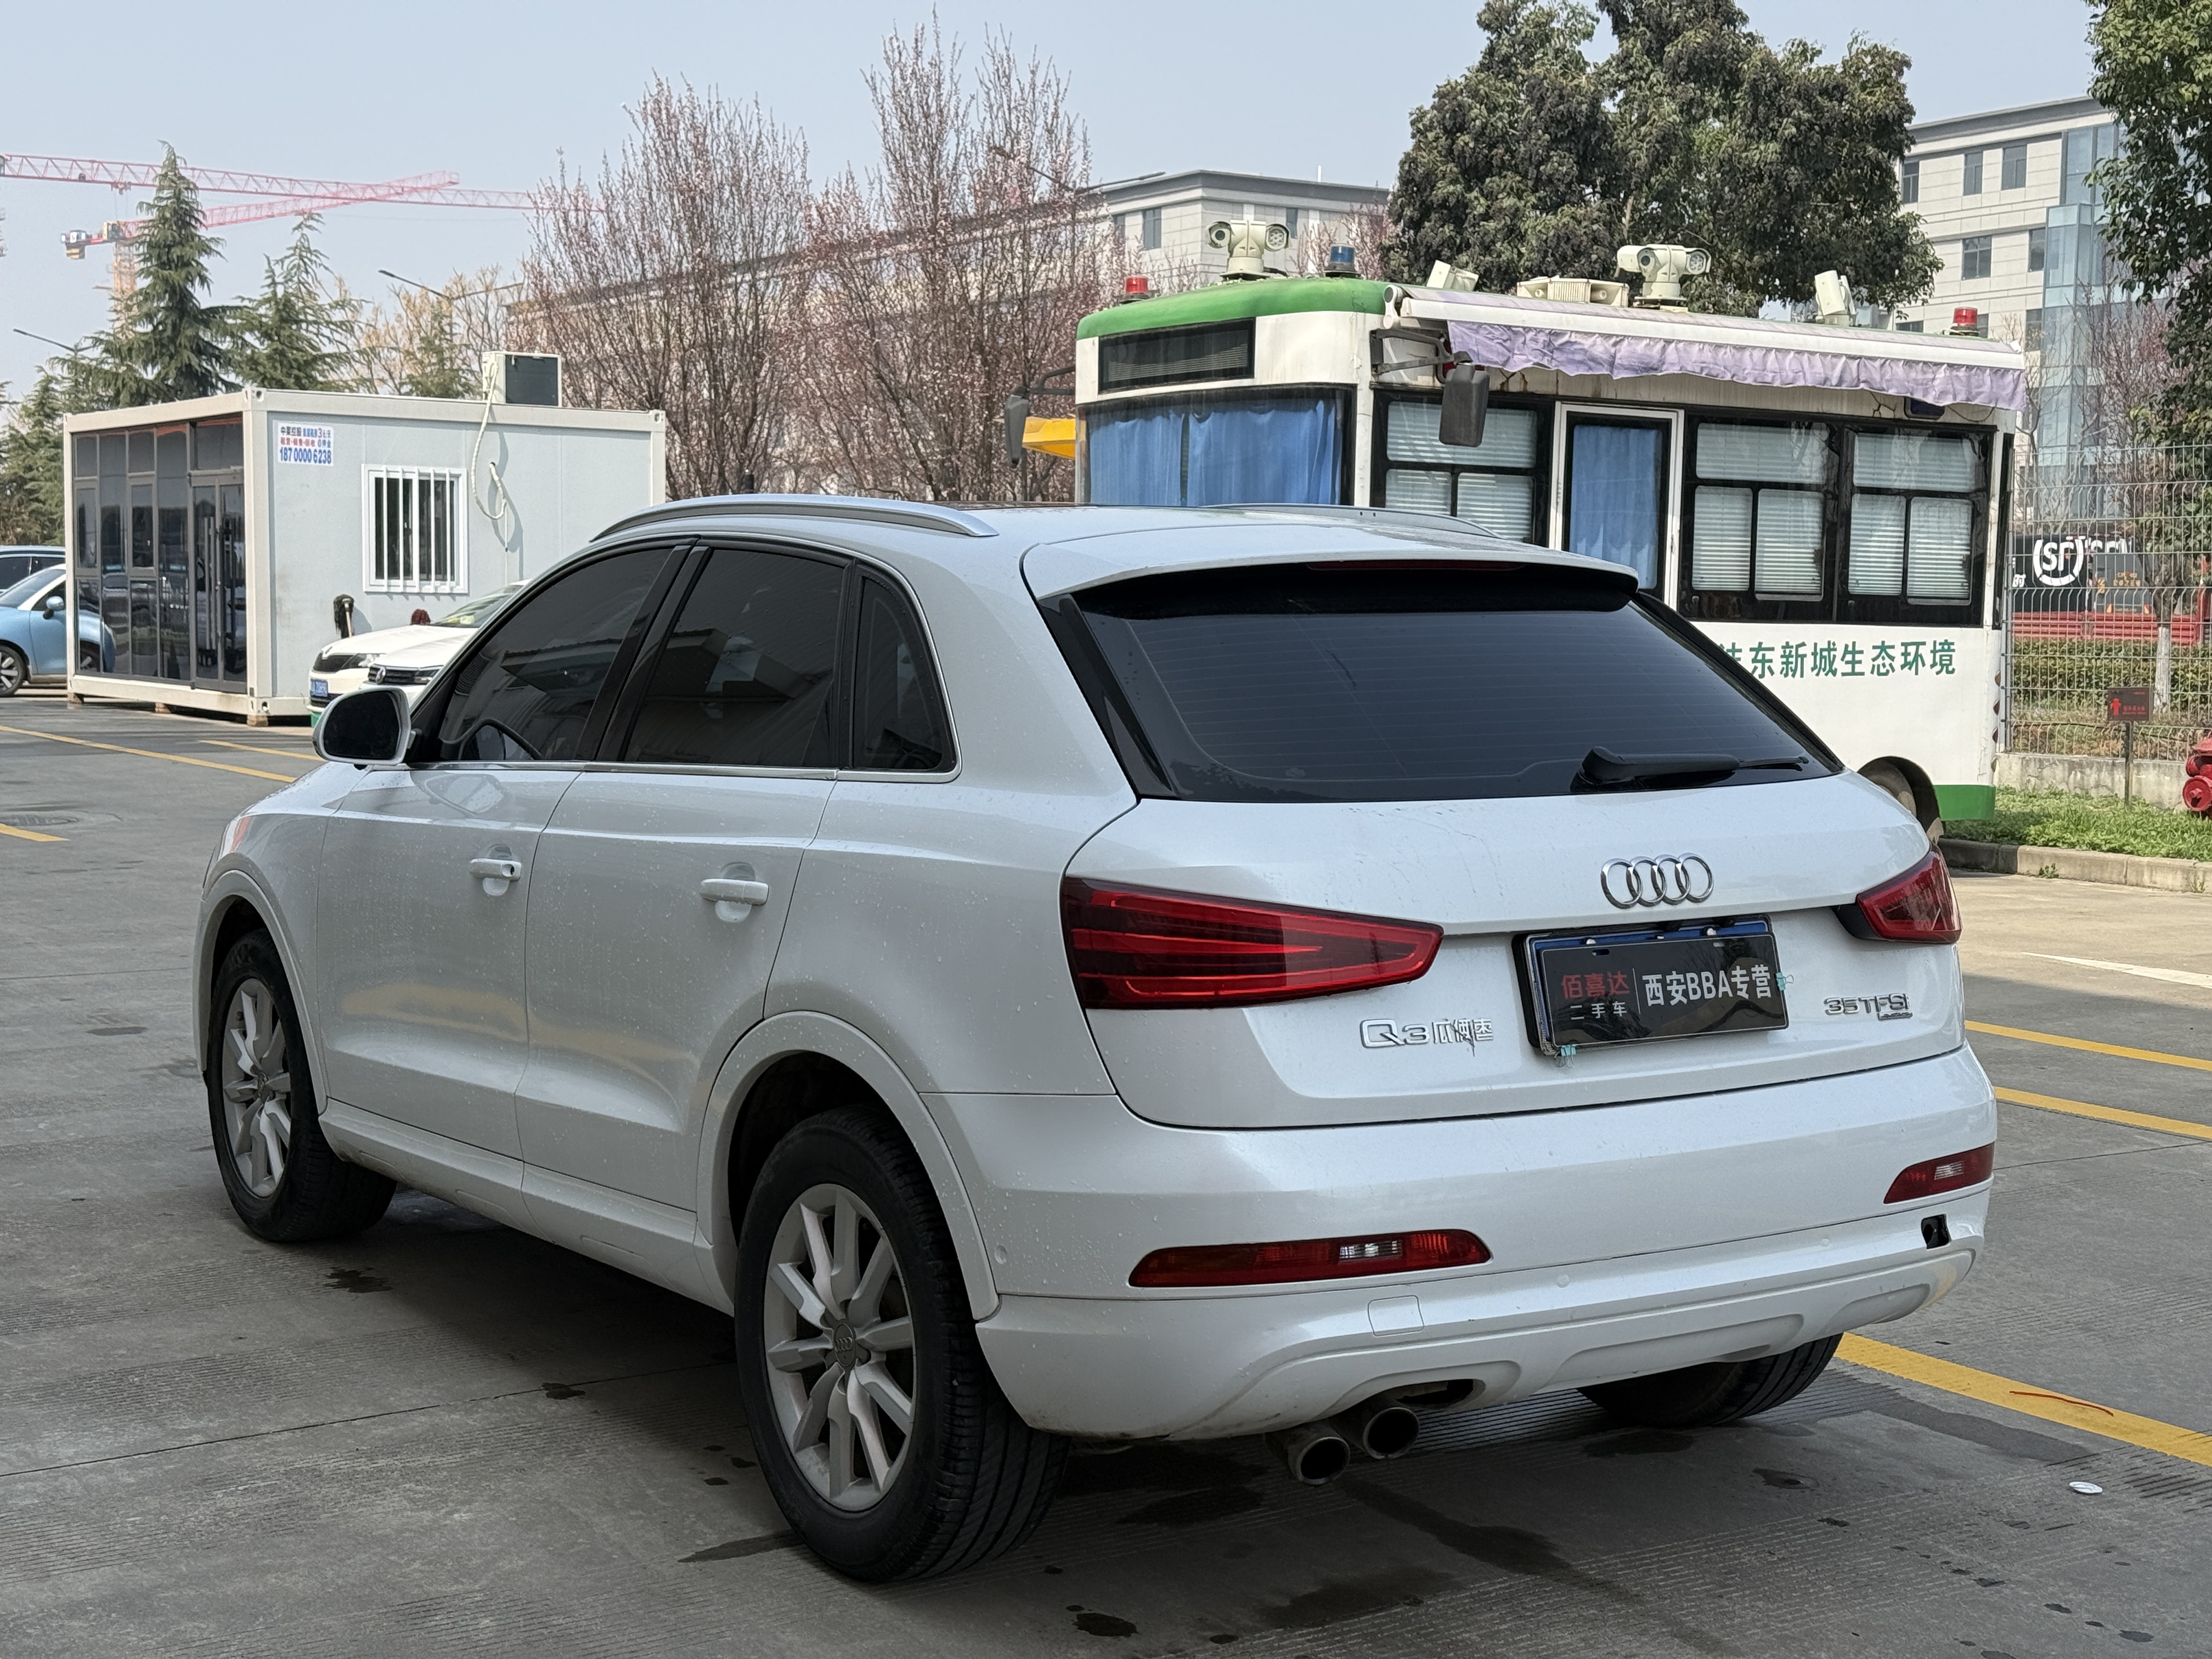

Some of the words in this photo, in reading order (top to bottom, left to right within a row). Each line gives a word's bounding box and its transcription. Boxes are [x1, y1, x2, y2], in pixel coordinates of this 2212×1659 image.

[280, 447, 292, 462] 187
[294, 447, 312, 463] 0000
[313, 448, 332, 464] 6238
[1561, 970, 1630, 1000] 佰喜达
[1641, 964, 1772, 1007] 西安BBA专营
[1570, 1001, 1627, 1020] 二手车
[1359, 1018, 1430, 1048] Q3
